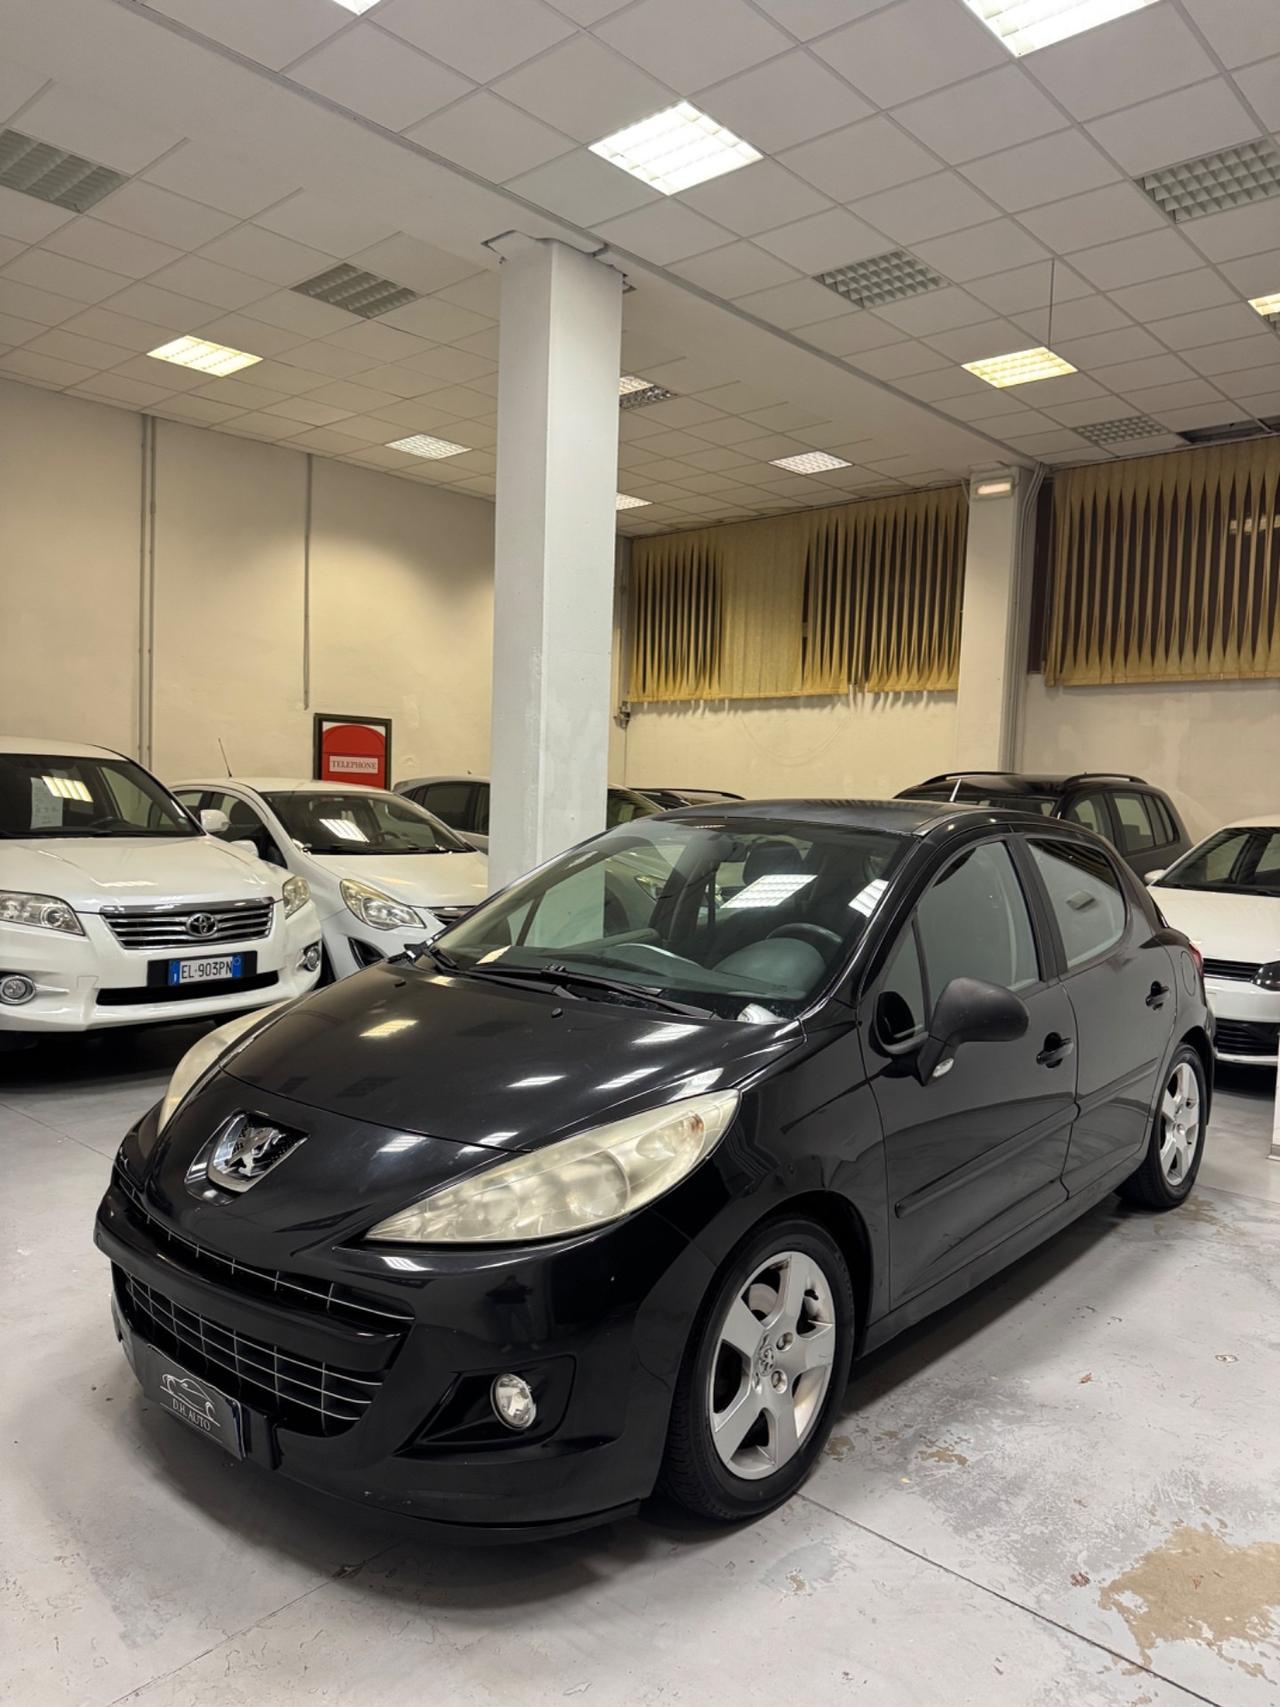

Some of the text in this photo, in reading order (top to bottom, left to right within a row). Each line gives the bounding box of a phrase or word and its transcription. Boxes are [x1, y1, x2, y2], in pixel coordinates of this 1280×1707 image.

[331, 760, 377, 770] TELEPHONE
[181, 960, 232, 979] EL 903PN
[187, 1410, 211, 1431] AUTO
